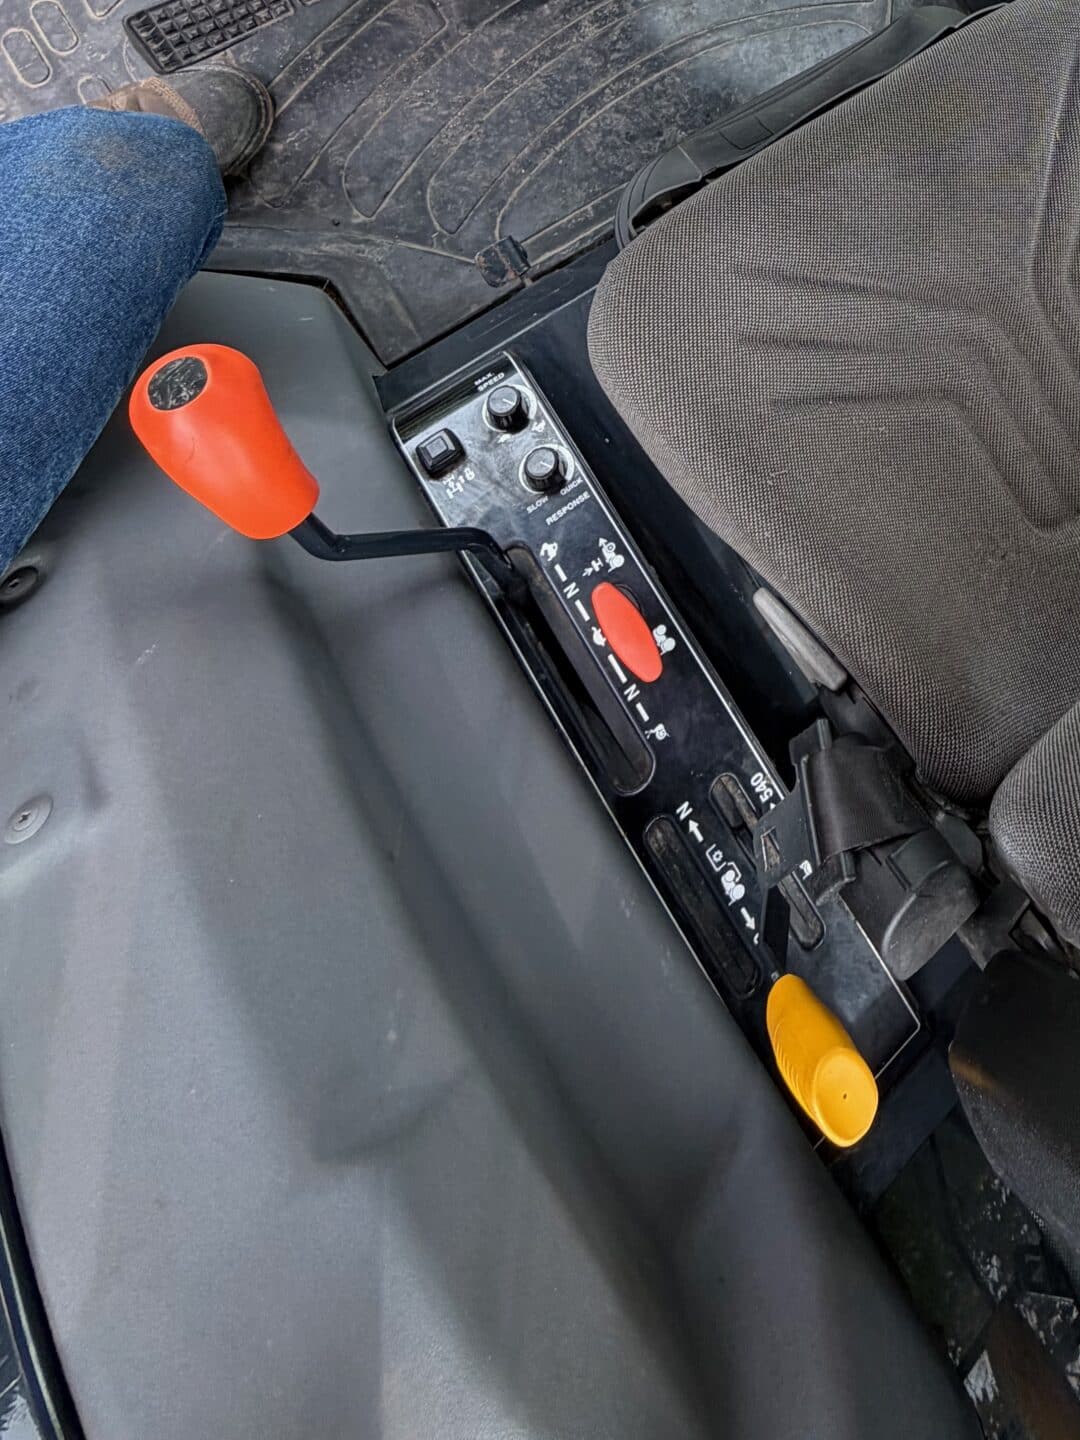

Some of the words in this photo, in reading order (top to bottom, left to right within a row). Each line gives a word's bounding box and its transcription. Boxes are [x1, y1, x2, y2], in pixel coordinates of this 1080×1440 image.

[478, 372, 505, 392] SPEED
[560, 478, 584, 496] QUICK
[526, 494, 549, 514] SLOW
[545, 491, 591, 526] RESPONSE
[563, 581, 580, 599] N
[624, 682, 641, 702] N
[750, 771, 774, 803] 540
[676, 800, 694, 820] N
